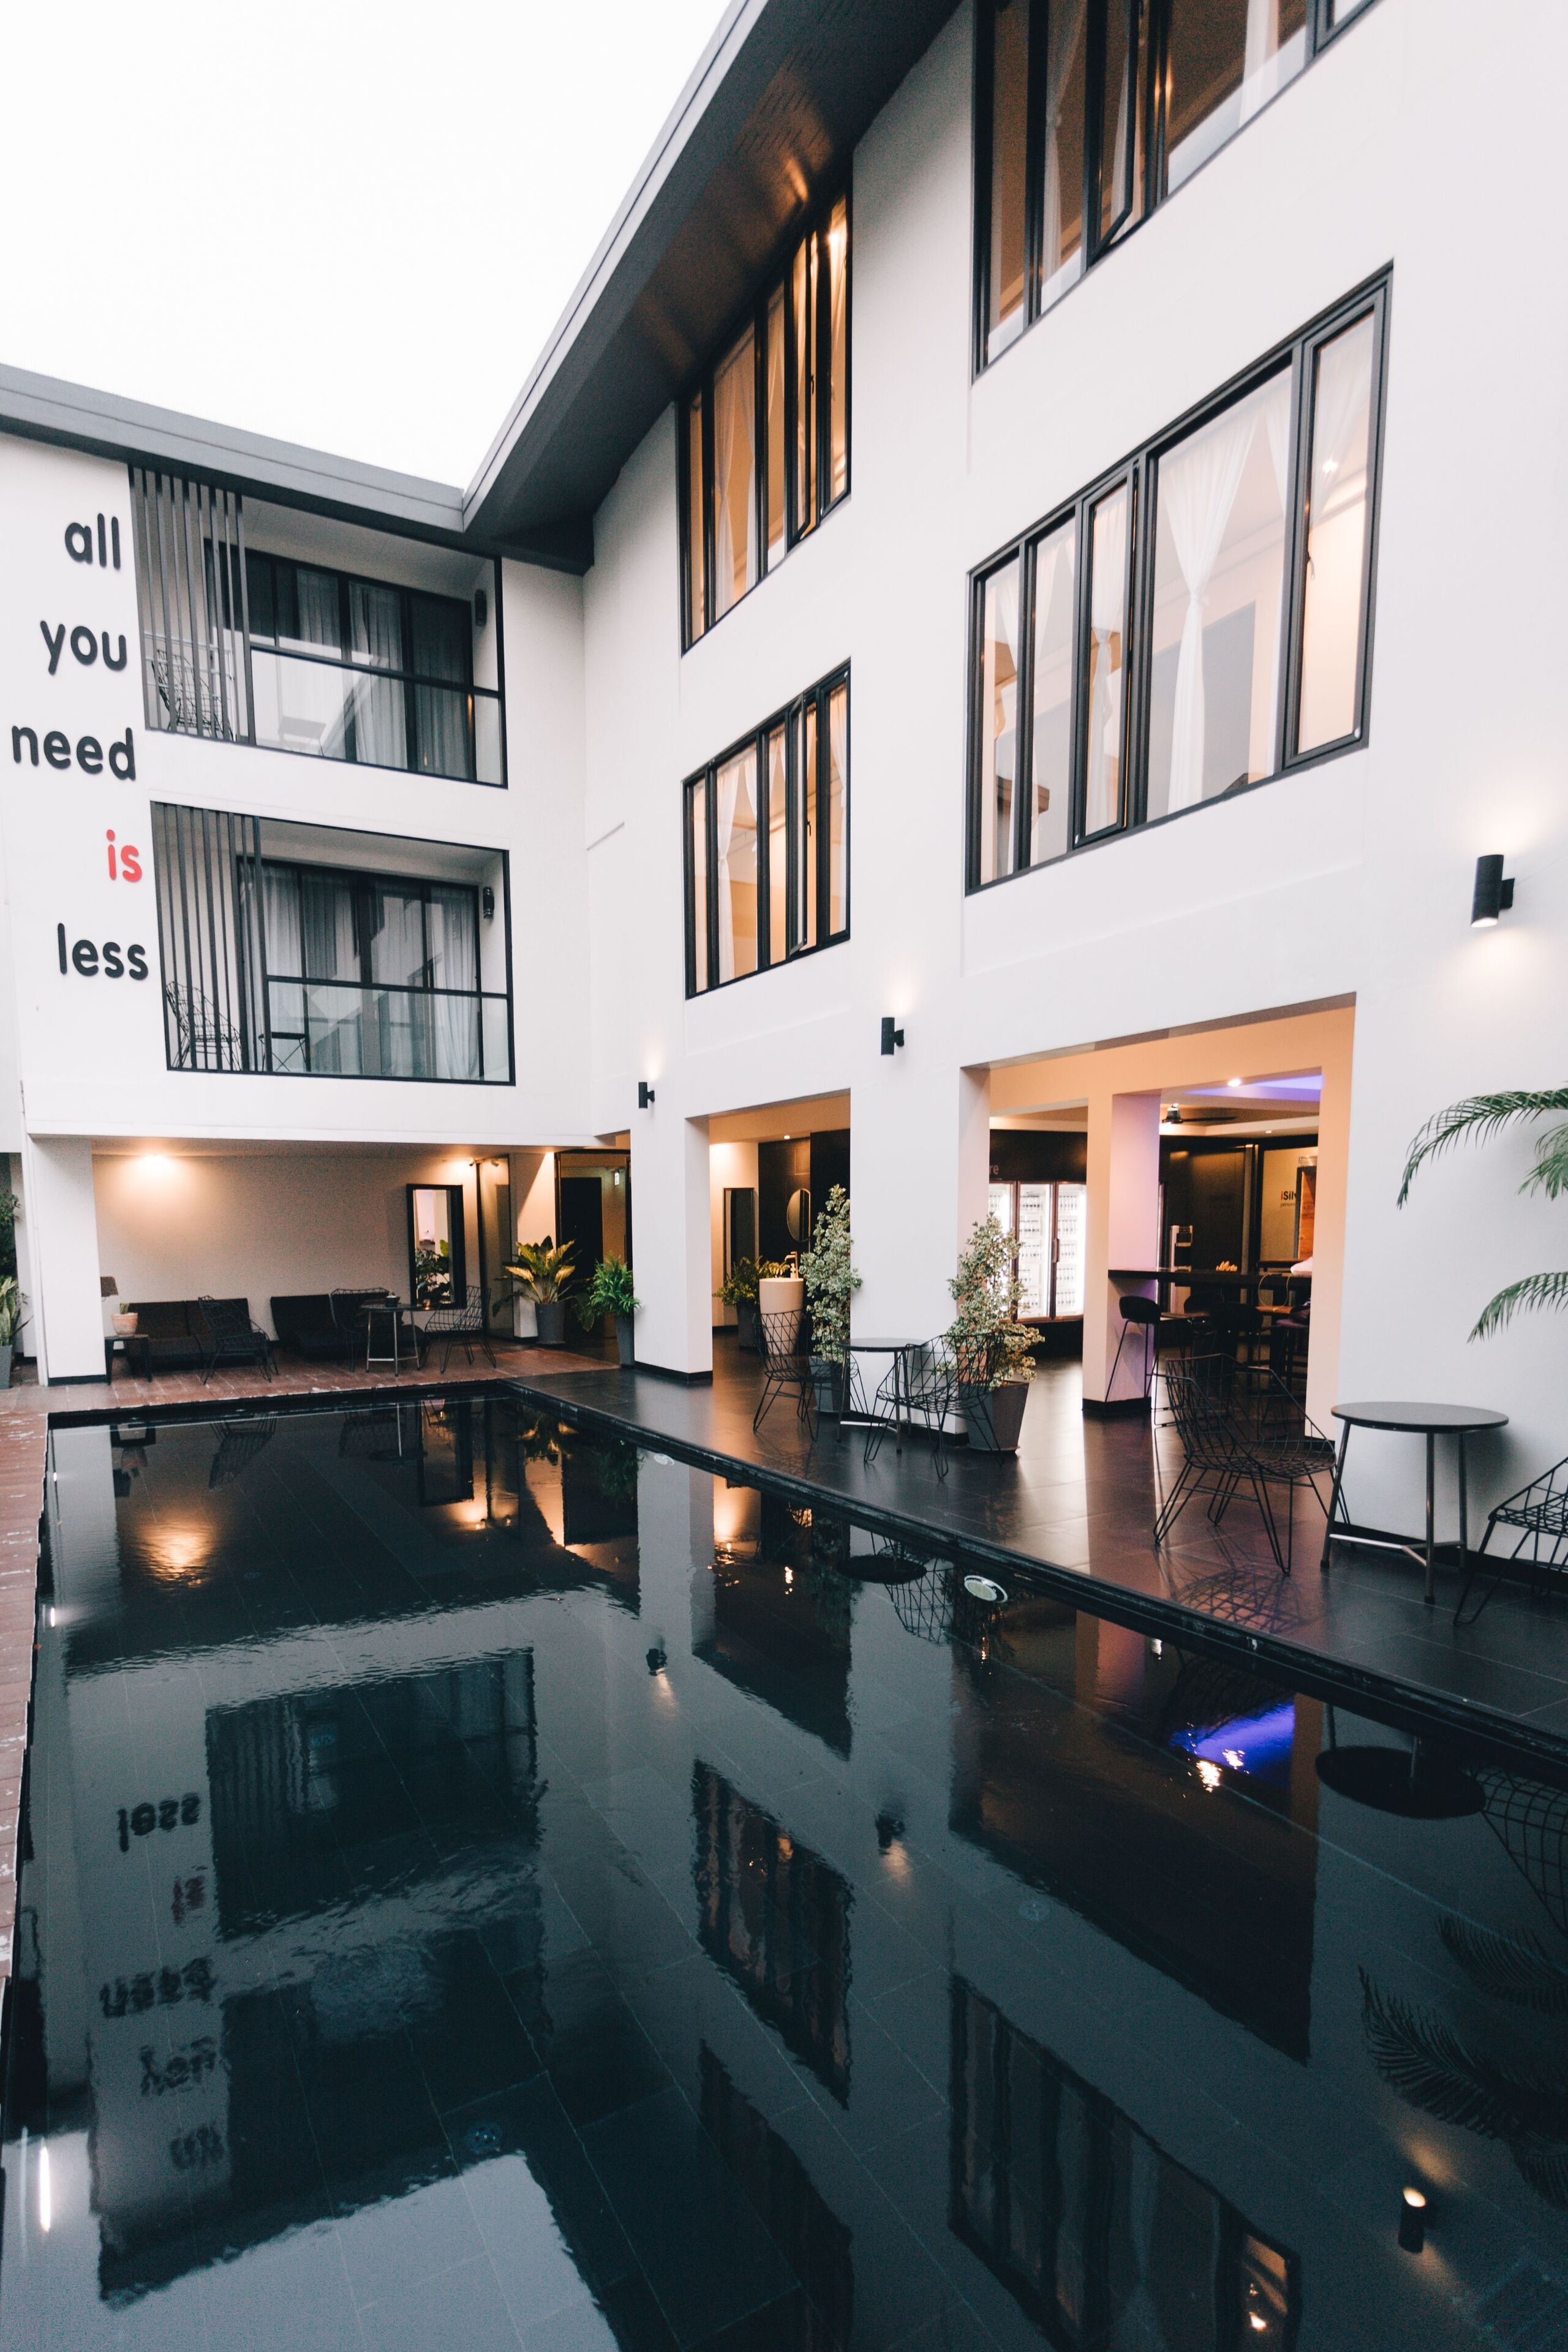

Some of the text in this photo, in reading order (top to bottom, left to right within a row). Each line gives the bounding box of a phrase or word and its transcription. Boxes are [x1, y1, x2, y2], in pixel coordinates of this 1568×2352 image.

[64, 513, 121, 570] all
[40, 620, 127, 676] you
[11, 725, 136, 782] need
[106, 829, 142, 883] is
[57, 922, 149, 981] less
